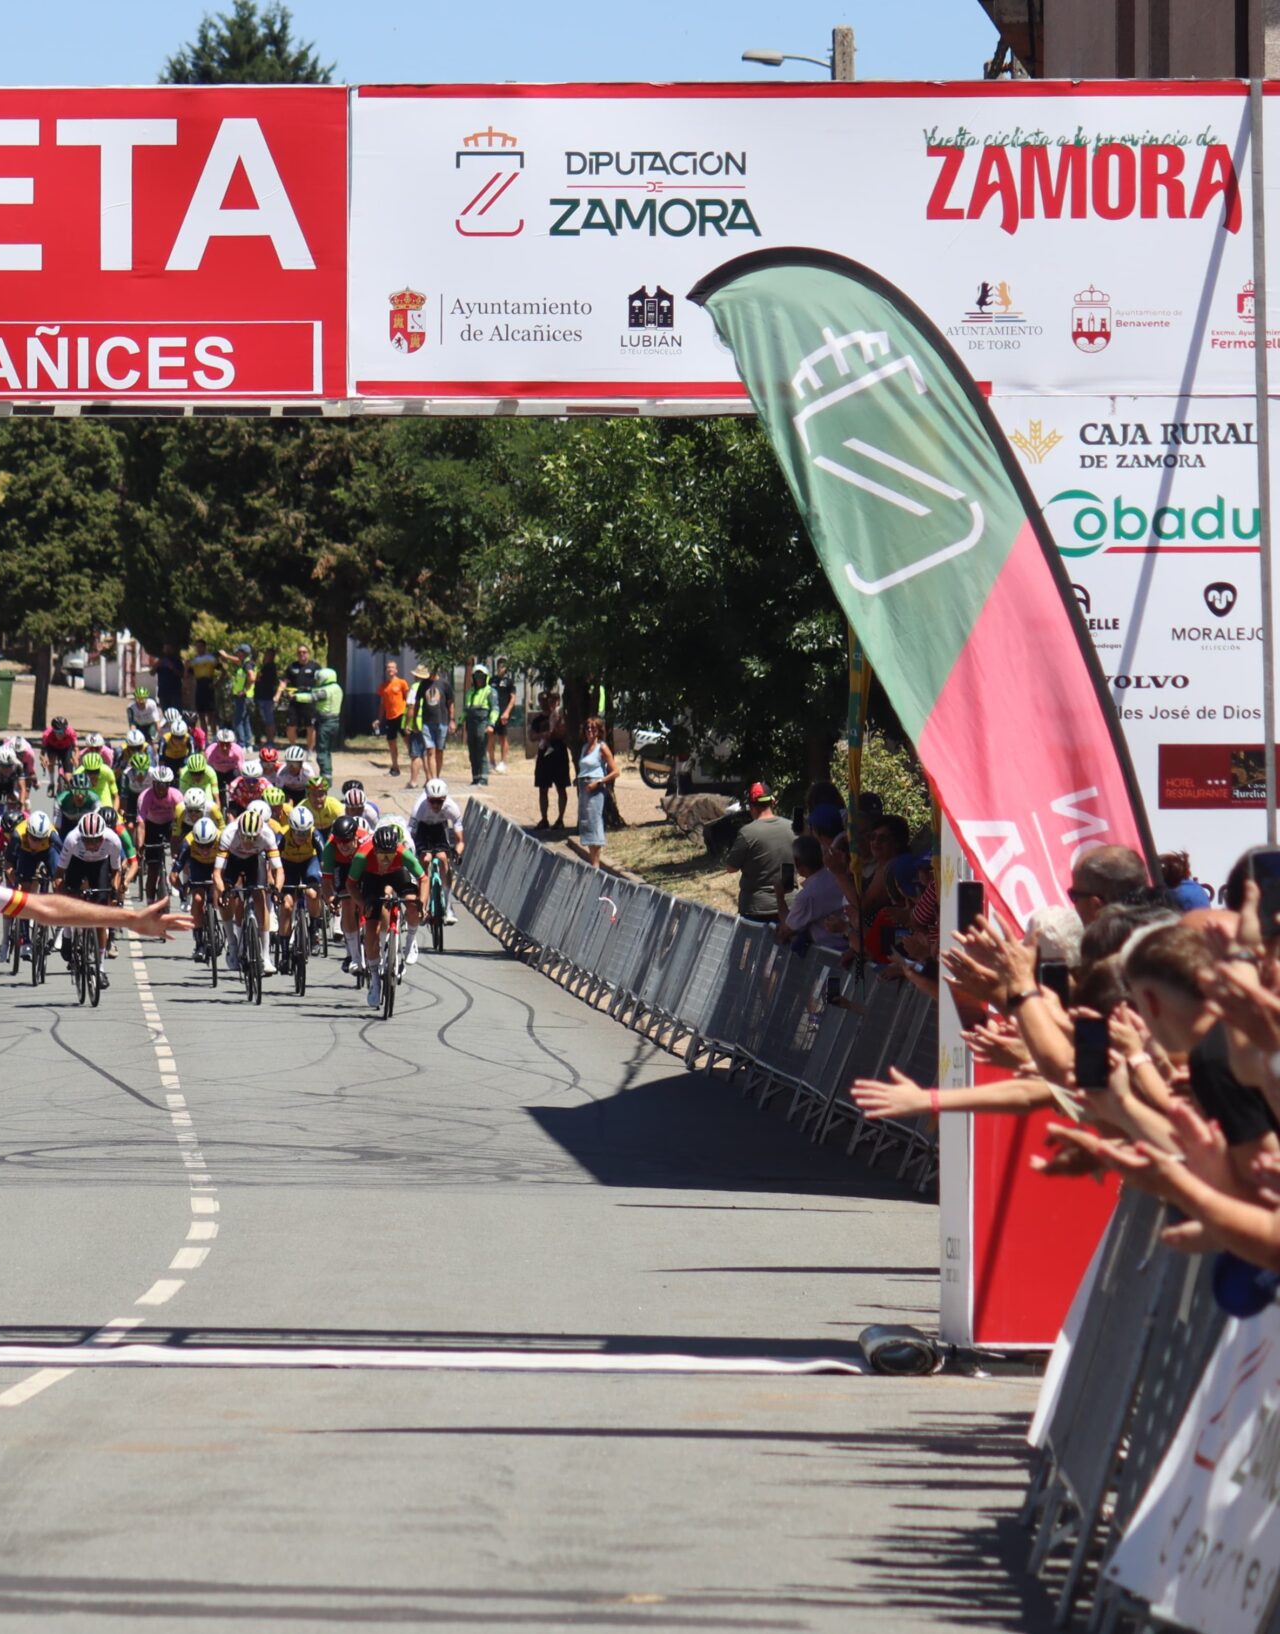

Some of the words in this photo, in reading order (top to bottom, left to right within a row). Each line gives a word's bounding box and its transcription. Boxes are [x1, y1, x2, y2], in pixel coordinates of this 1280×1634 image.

[926, 142, 1243, 235] ZAMORA
[549, 198, 762, 237] ZAMORA
[450, 297, 592, 319] Ayuntamiento
[946, 325, 1043, 337] AYUNTAMIENTO
[1116, 319, 1171, 328] Benavente
[460, 324, 484, 342] de
[488, 323, 583, 343] Alcañices
[620, 332, 682, 347] LUBIÁN
[968, 340, 986, 350] DE
[988, 340, 1021, 350] TORO
[1079, 423, 1152, 446] CAJA
[1160, 423, 1258, 445] RURAL
[1080, 454, 1107, 469] DE
[1116, 454, 1206, 468] ZAMORA
[1149, 705, 1190, 720] José
[1196, 705, 1217, 720] de
[1223, 705, 1261, 720] Dios
[1166, 778, 1195, 787] HOTEL
